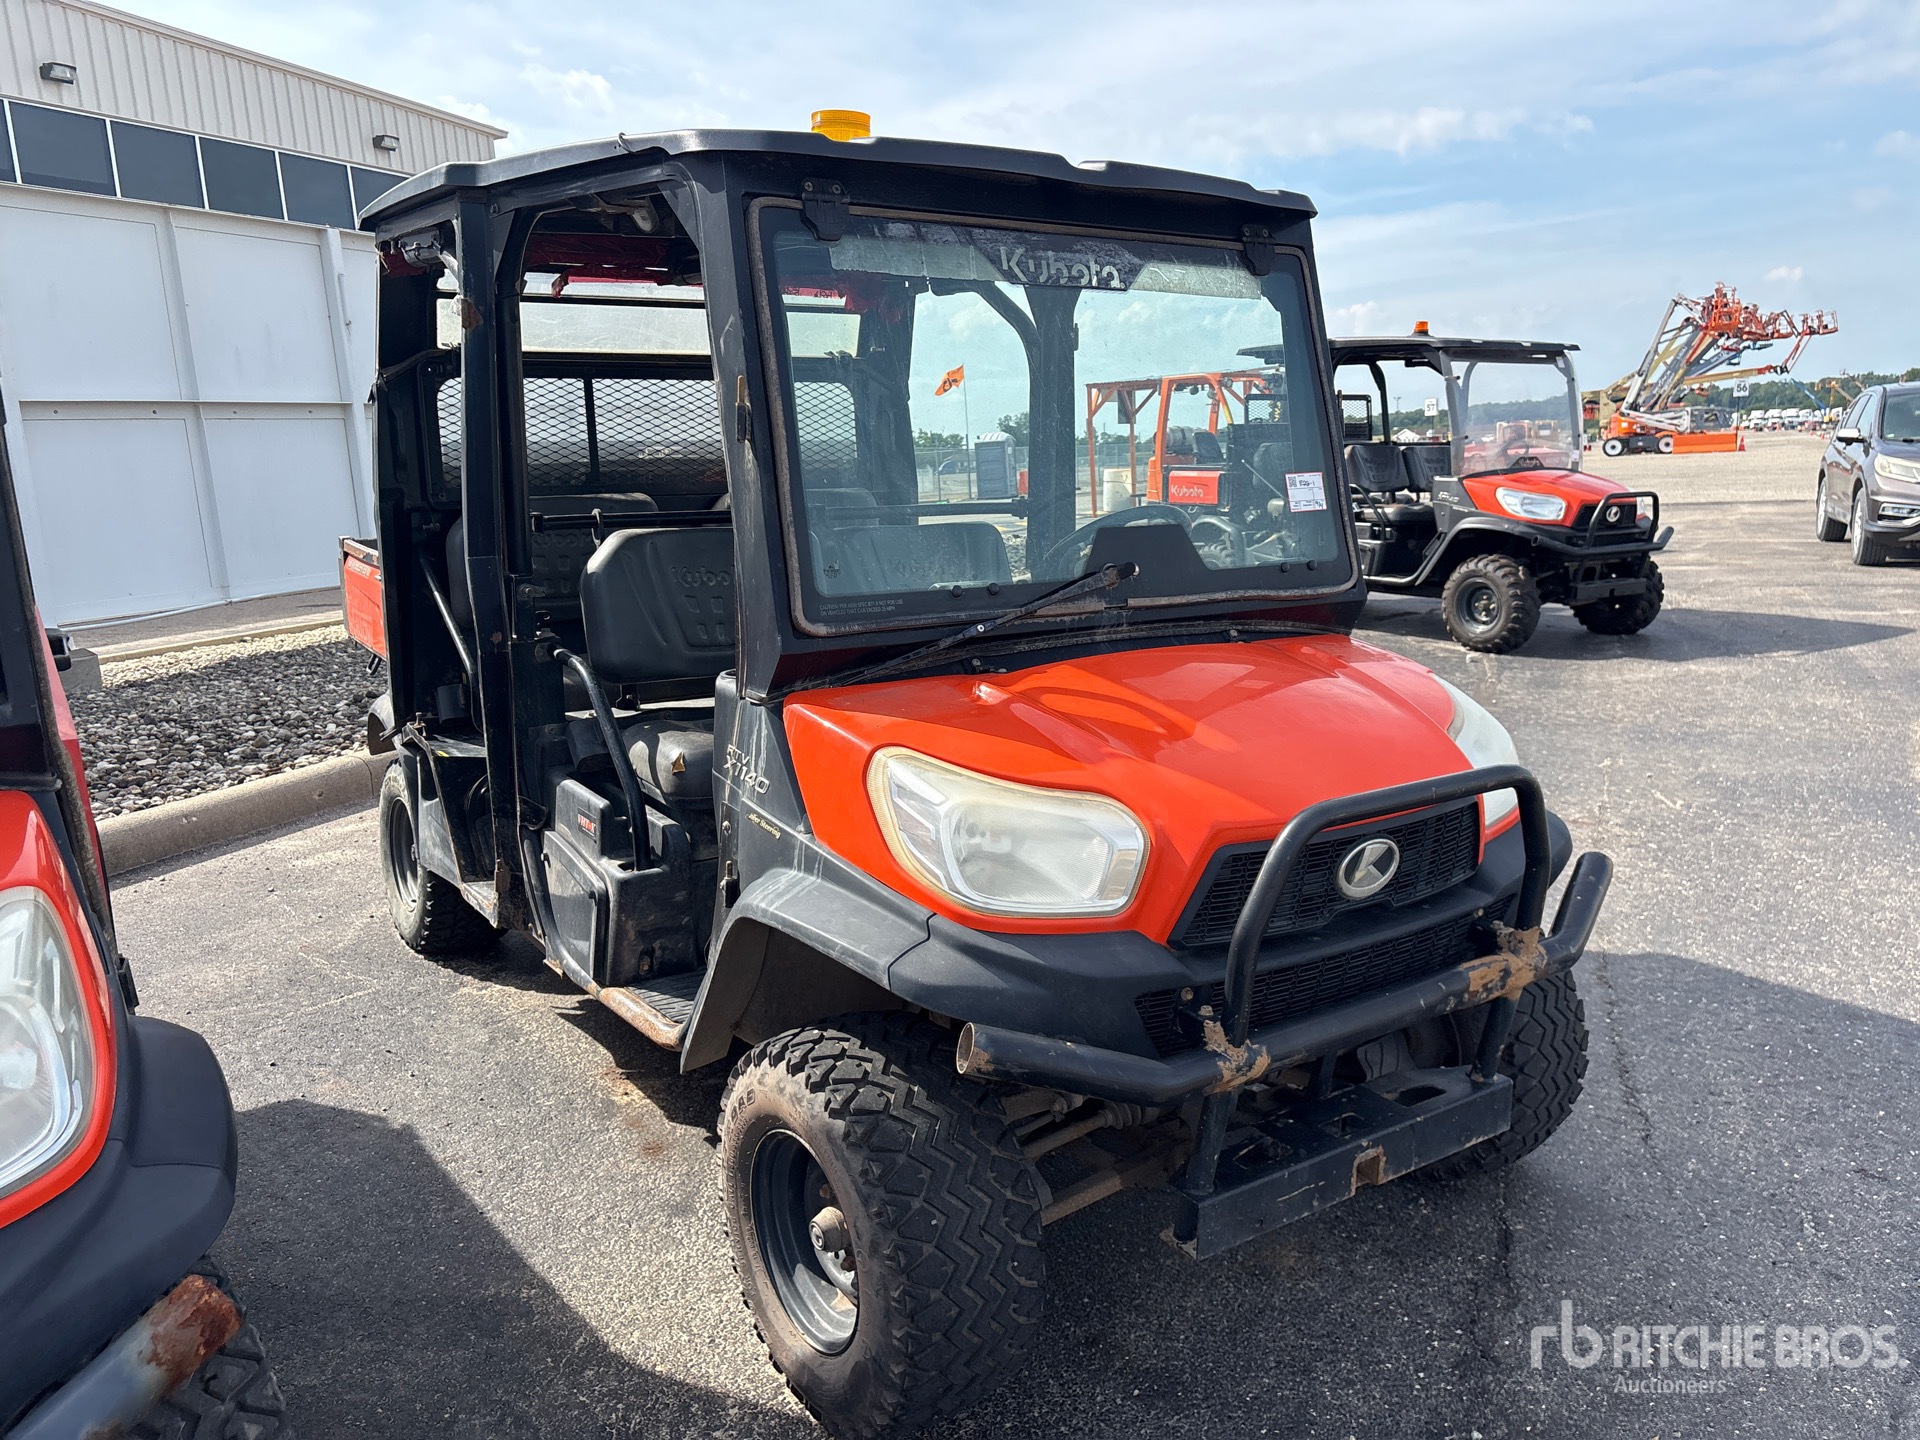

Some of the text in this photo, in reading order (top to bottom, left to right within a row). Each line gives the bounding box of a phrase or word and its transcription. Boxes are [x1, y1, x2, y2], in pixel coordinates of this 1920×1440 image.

[1000, 246, 1121, 288] Kubota
[1736, 383, 1748, 393] 56
[1426, 403, 1436, 412] 57
[1170, 485, 1204, 498] Kubota
[671, 565, 735, 587] Kubo
[727, 744, 750, 765] RTV
[723, 755, 770, 794] X1140
